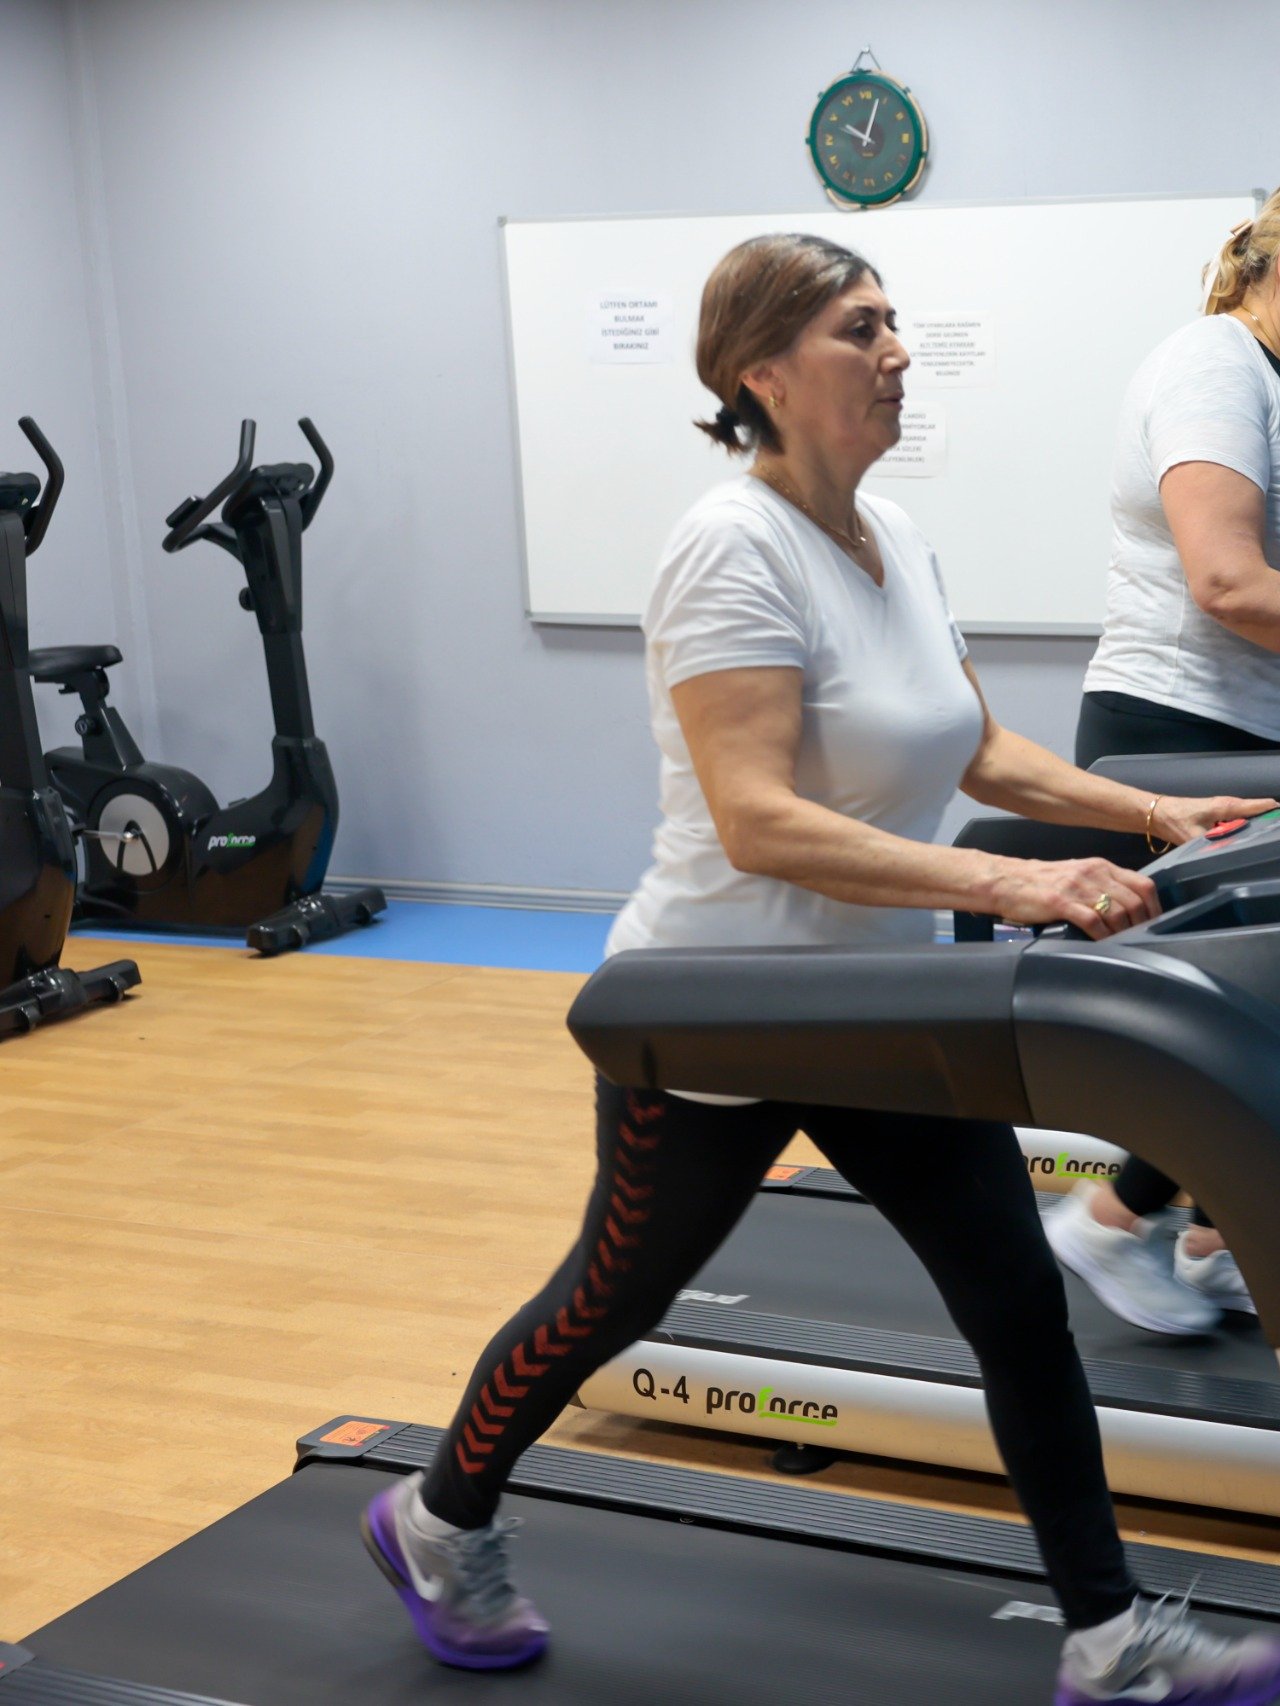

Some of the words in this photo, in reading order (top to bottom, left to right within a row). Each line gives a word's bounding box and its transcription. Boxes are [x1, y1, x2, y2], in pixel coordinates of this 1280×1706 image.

[600, 300, 627, 309] LÜTFEN
[628, 301, 658, 309] ORTAMI
[614, 315, 645, 323] BULMAK
[207, 832, 256, 851] proforce
[632, 1368, 690, 1404] Q-4
[706, 1386, 838, 1427] proforce
